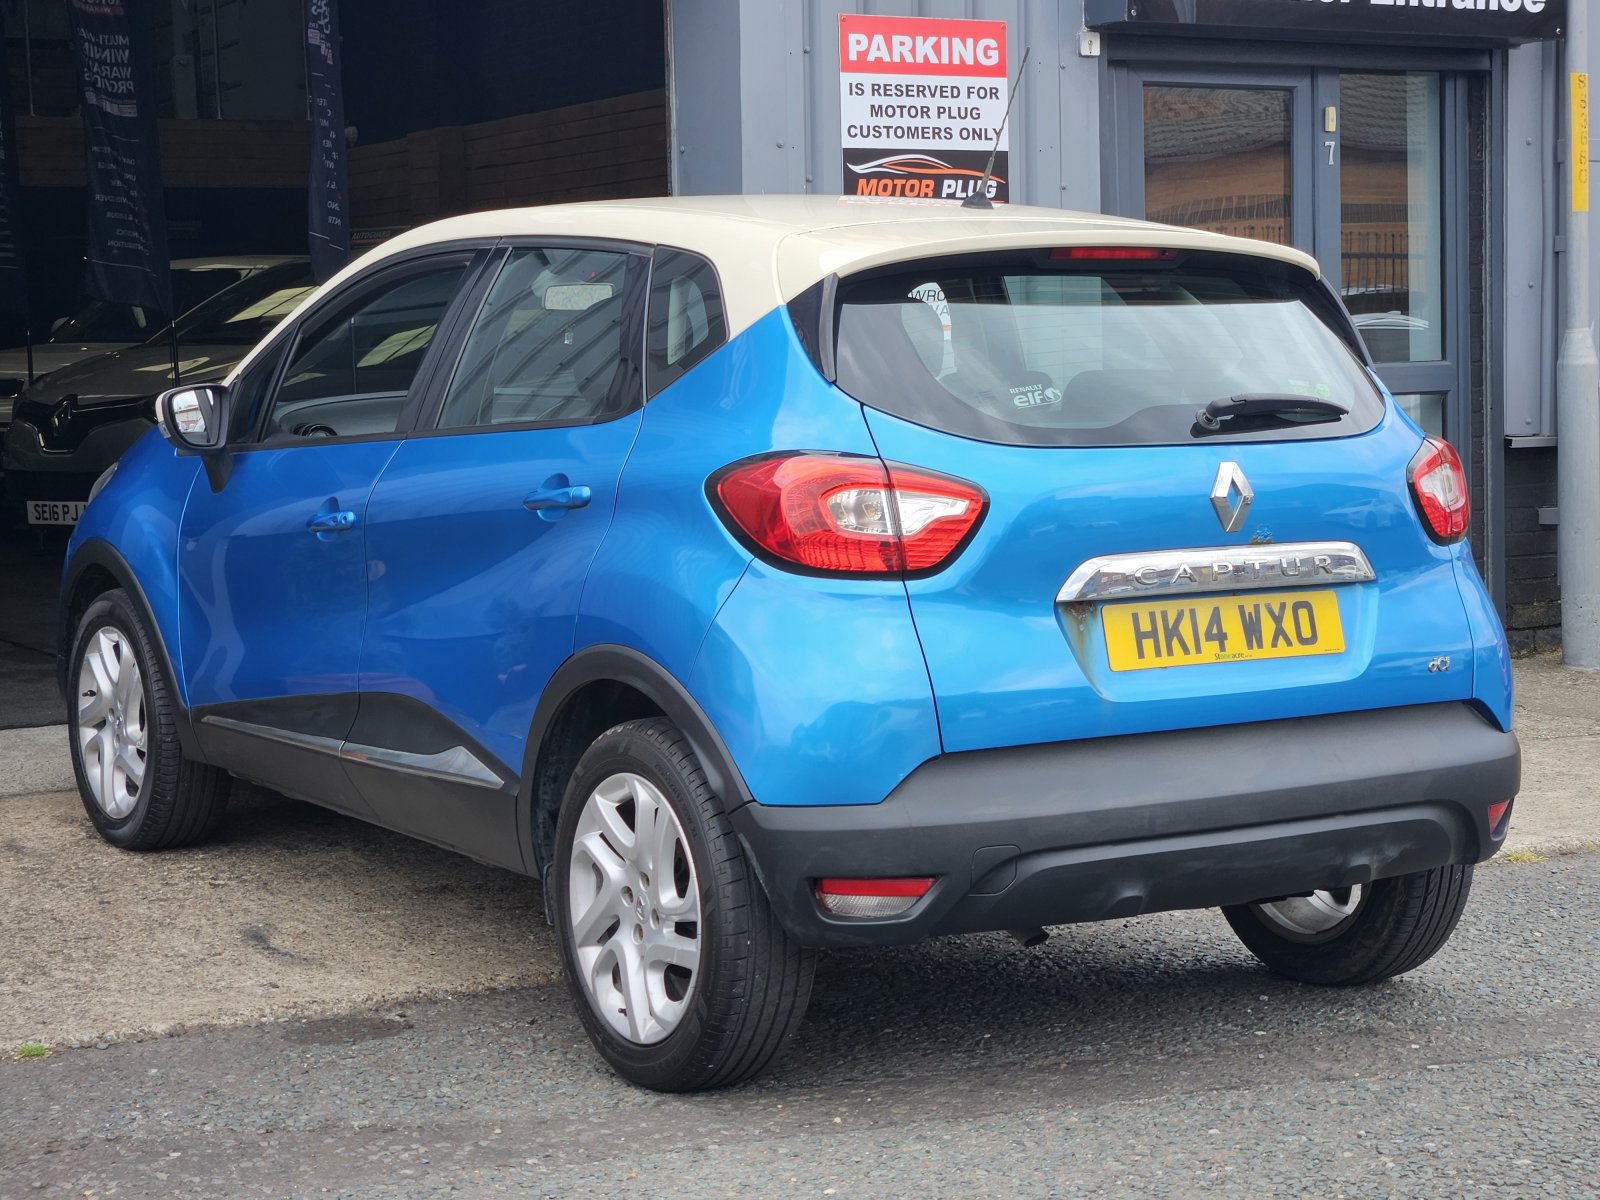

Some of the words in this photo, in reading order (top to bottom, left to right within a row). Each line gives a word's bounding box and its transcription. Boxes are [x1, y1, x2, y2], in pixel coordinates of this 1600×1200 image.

[848, 33, 999, 66] PARKING
[849, 82, 865, 96] IS
[871, 83, 961, 99] RESERVED
[967, 86, 1000, 100] FOR
[870, 104, 931, 119] MOTOR
[937, 106, 981, 120] PLUG
[847, 125, 953, 140] CUSTOMERS
[959, 127, 1002, 141] ONLY
[1325, 141, 1336, 165] 7
[856, 178, 935, 197] MOTOR
[911, 289, 946, 301] WRO
[1009, 384, 1043, 394] RENAULT
[1013, 391, 1043, 407] elf
[34, 504, 60, 521] SE16
[62, 504, 86, 521] PJ
[1134, 555, 1334, 586] CAPTUR
[1132, 606, 1228, 659] HK14
[1238, 600, 1318, 651] WXO
